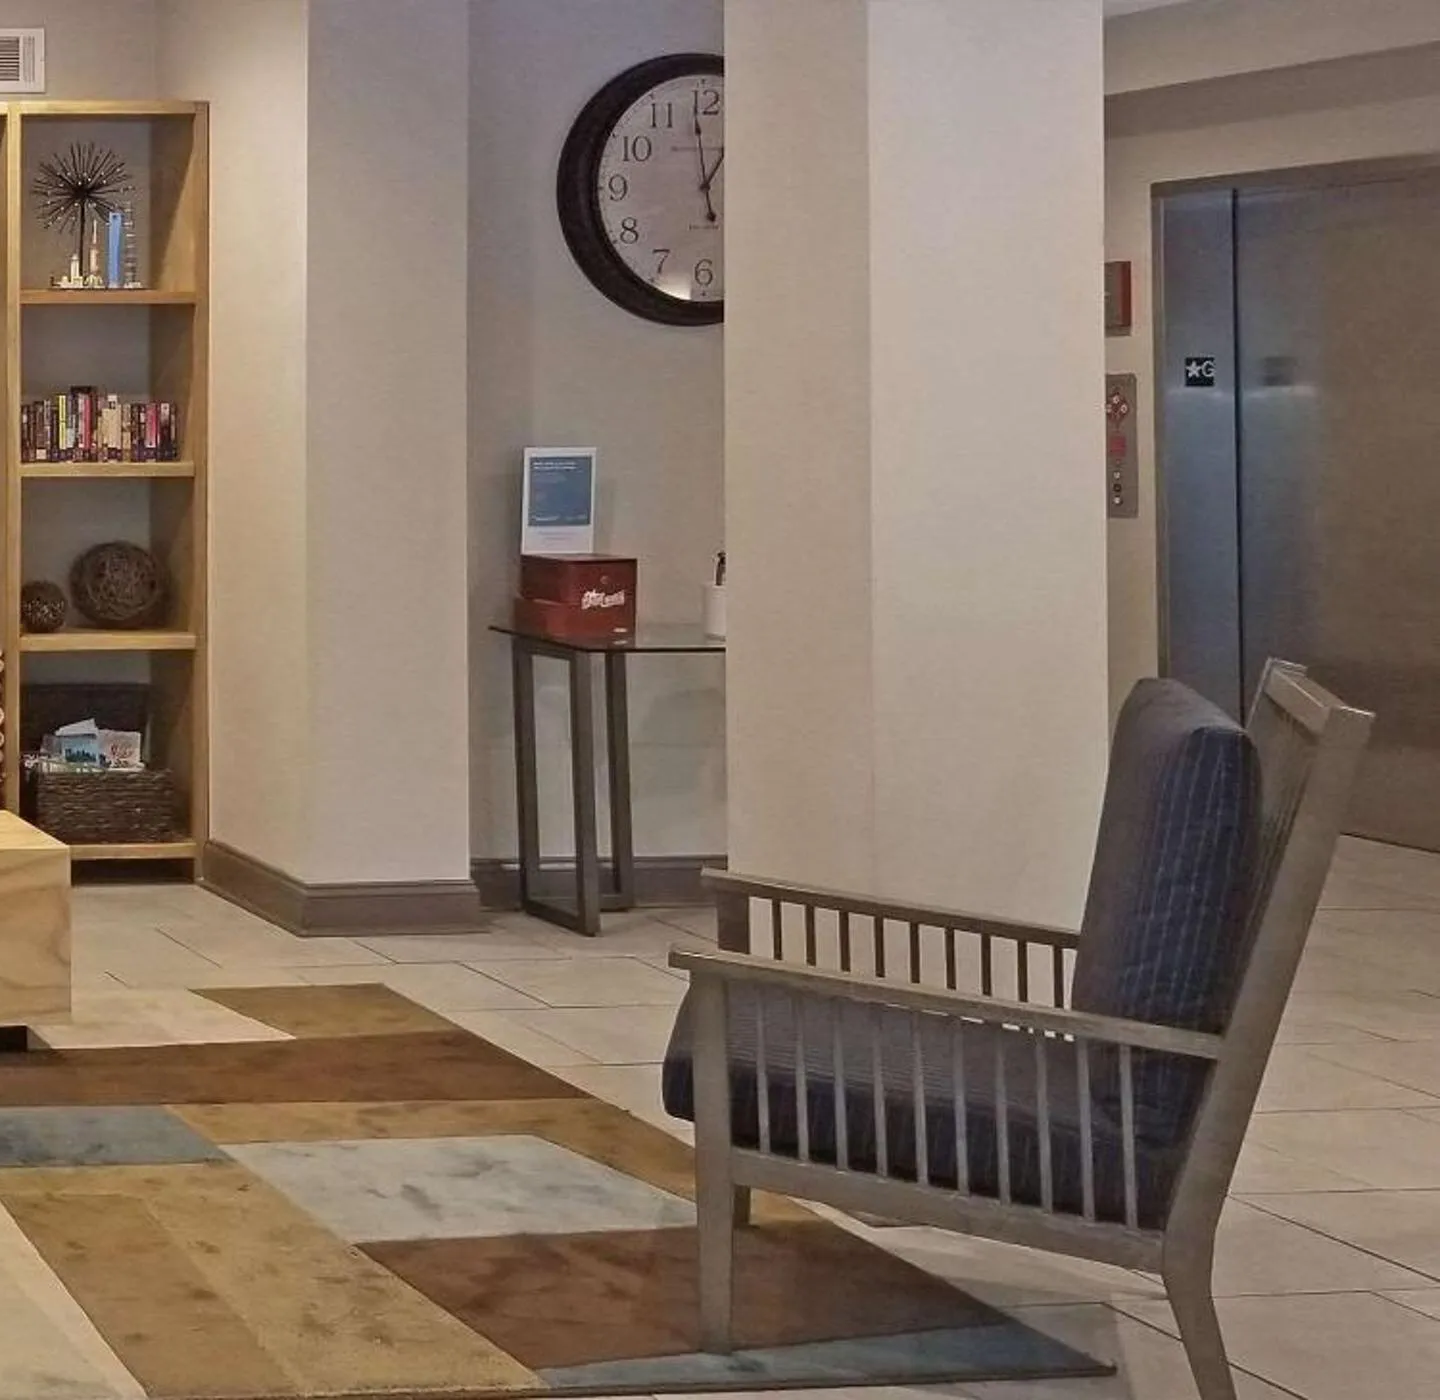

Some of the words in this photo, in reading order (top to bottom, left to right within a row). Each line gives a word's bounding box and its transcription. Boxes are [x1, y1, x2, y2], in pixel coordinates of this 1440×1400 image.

[650, 102, 674, 129] 11
[692, 89, 721, 116] 12
[622, 135, 652, 162] 10
[608, 174, 628, 202] 9
[619, 217, 639, 244] 8
[653, 249, 670, 275] 7
[694, 259, 714, 286] 6
[1201, 360, 1216, 377] G
